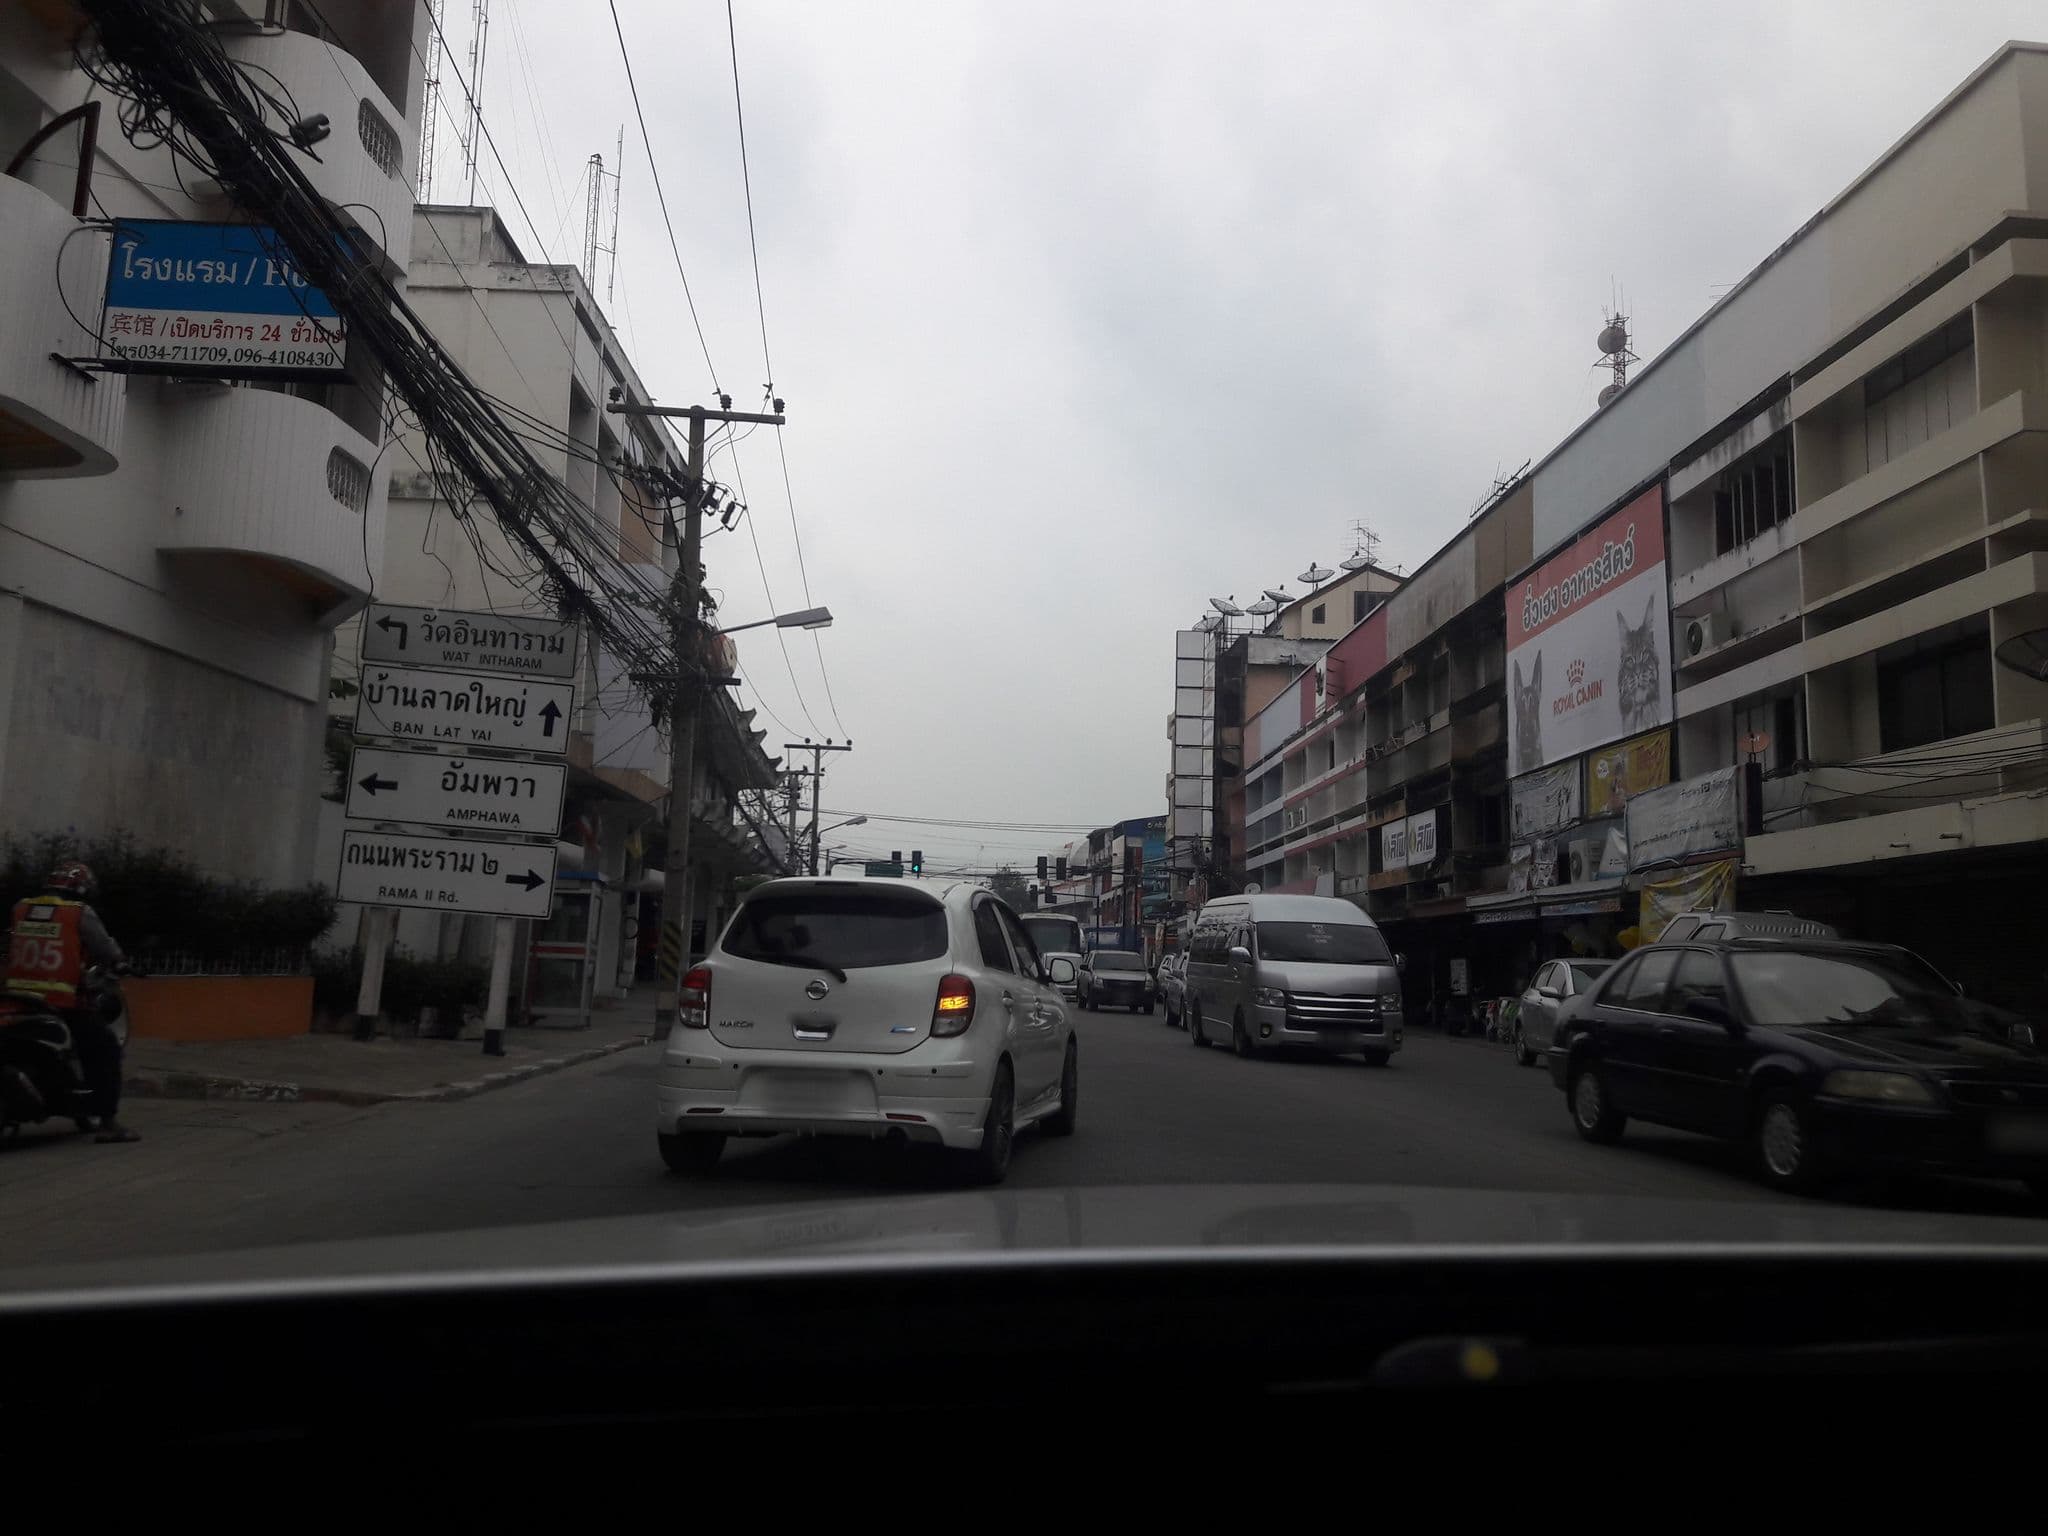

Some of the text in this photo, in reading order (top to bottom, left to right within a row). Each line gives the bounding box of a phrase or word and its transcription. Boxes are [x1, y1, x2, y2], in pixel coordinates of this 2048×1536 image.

[121, 241, 236, 285] โรงแรม
[110, 313, 155, 336] 宾馆
[262, 324, 281, 341] 24
[1560, 522, 1635, 607] อาหารสัตว์
[420, 613, 564, 654] วัดอินทาราม
[443, 651, 542, 669] WAT INTHARAM
[367, 673, 527, 727] บ้านลาดใหญ่
[1552, 679, 1602, 717] ROYAL CANIN
[393, 722, 491, 741] BAN LAT YAI
[441, 761, 536, 798] อัมพวา
[446, 809, 520, 824] AMPHAWA
[347, 843, 499, 876] ถนนพระราม ๒
[378, 886, 418, 899] RAMA
[438, 890, 459, 903] Rd.
